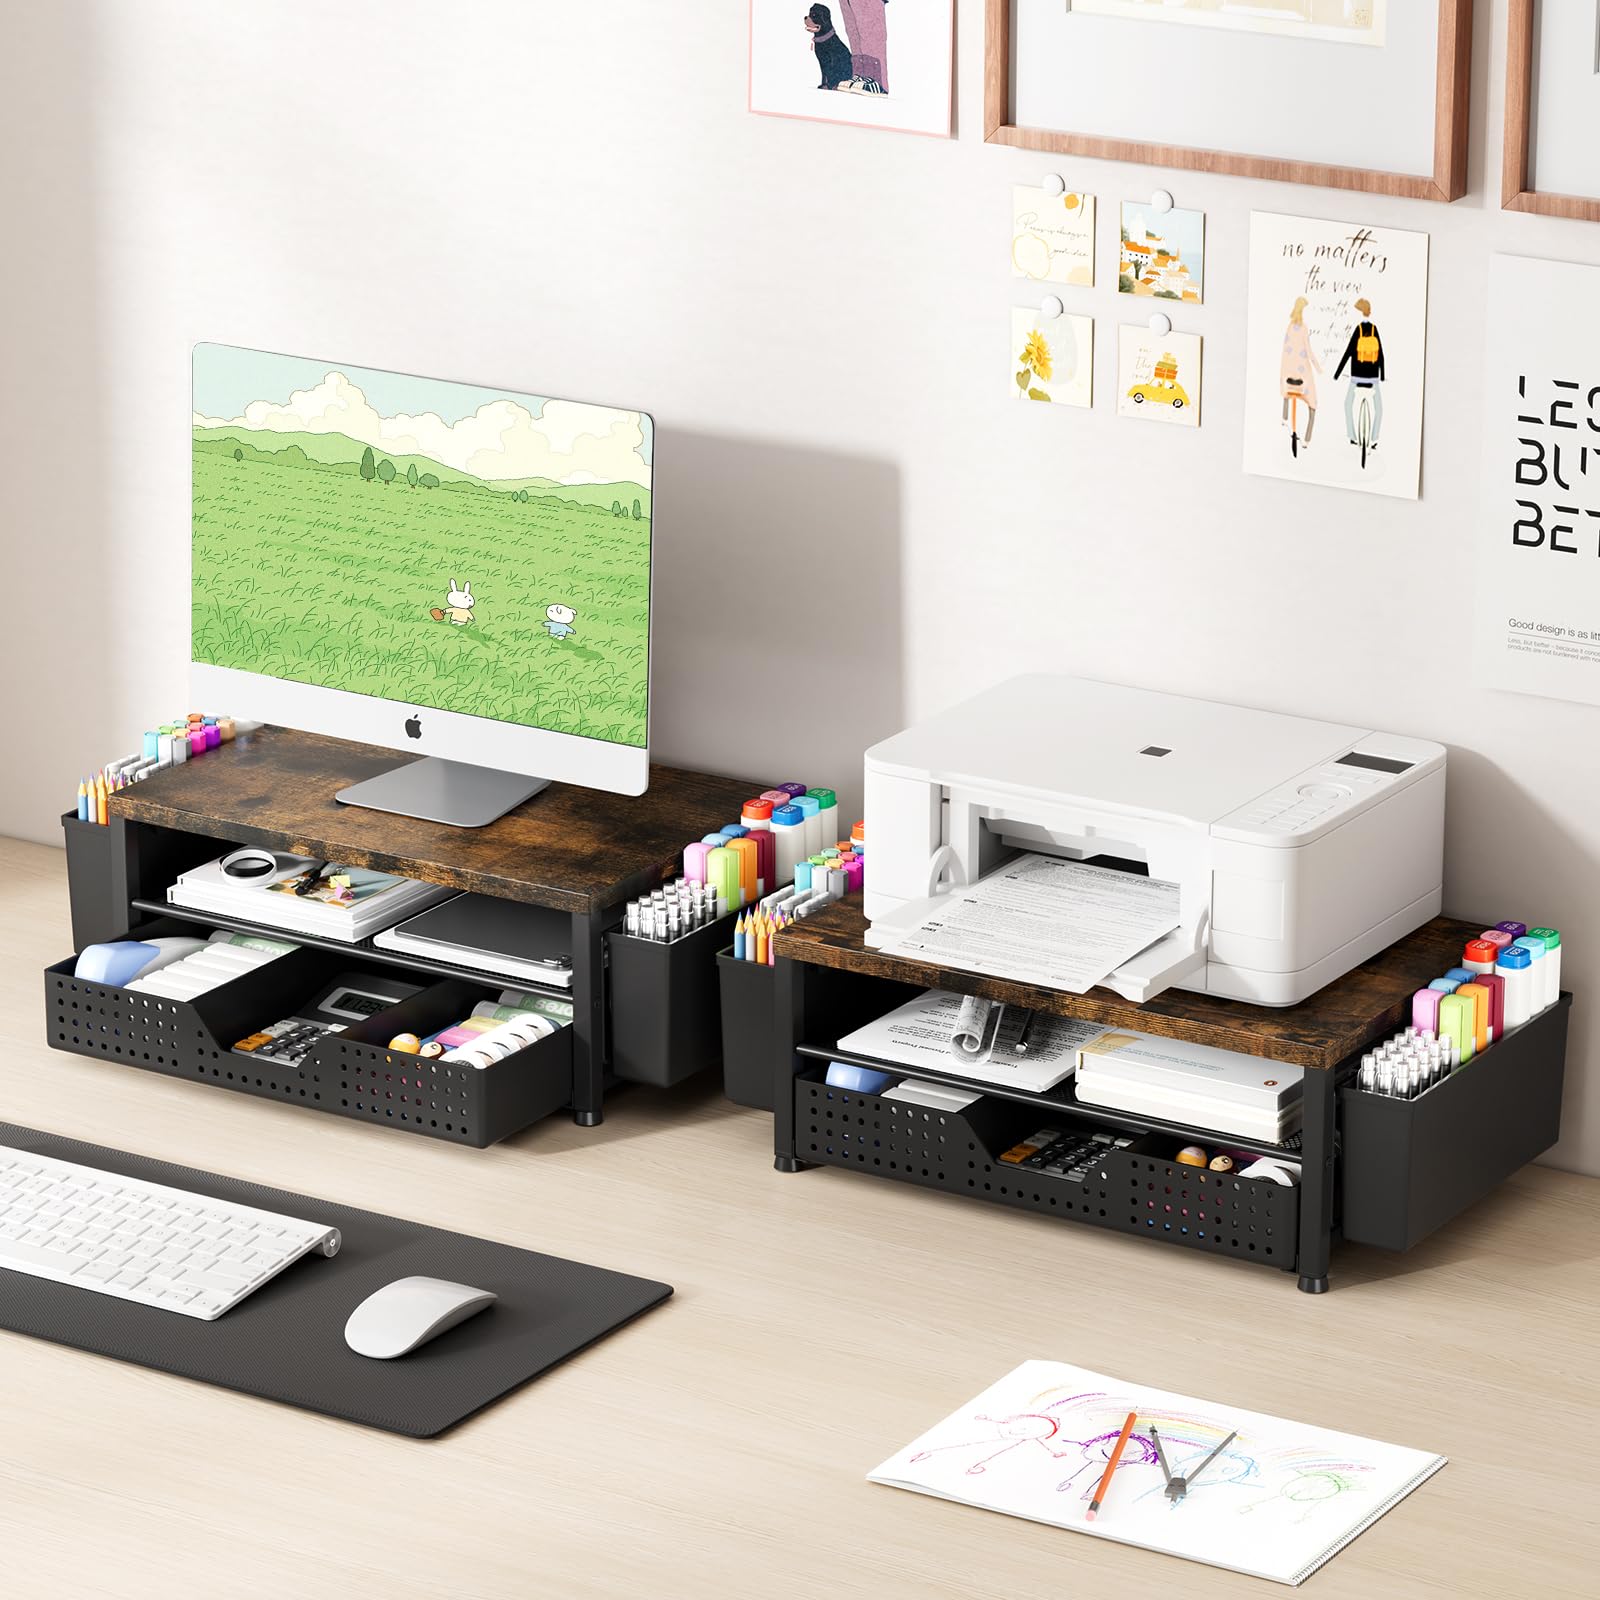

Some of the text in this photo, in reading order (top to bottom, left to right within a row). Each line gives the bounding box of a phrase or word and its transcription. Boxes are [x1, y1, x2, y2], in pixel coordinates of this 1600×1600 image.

[1282, 228, 1389, 273] no matters
[1304, 265, 1327, 294] the
[1508, 618, 1534, 631] Good
[1536, 623, 1566, 636] design
[1567, 628, 1576, 637] is
[1577, 631, 1589, 639] as
